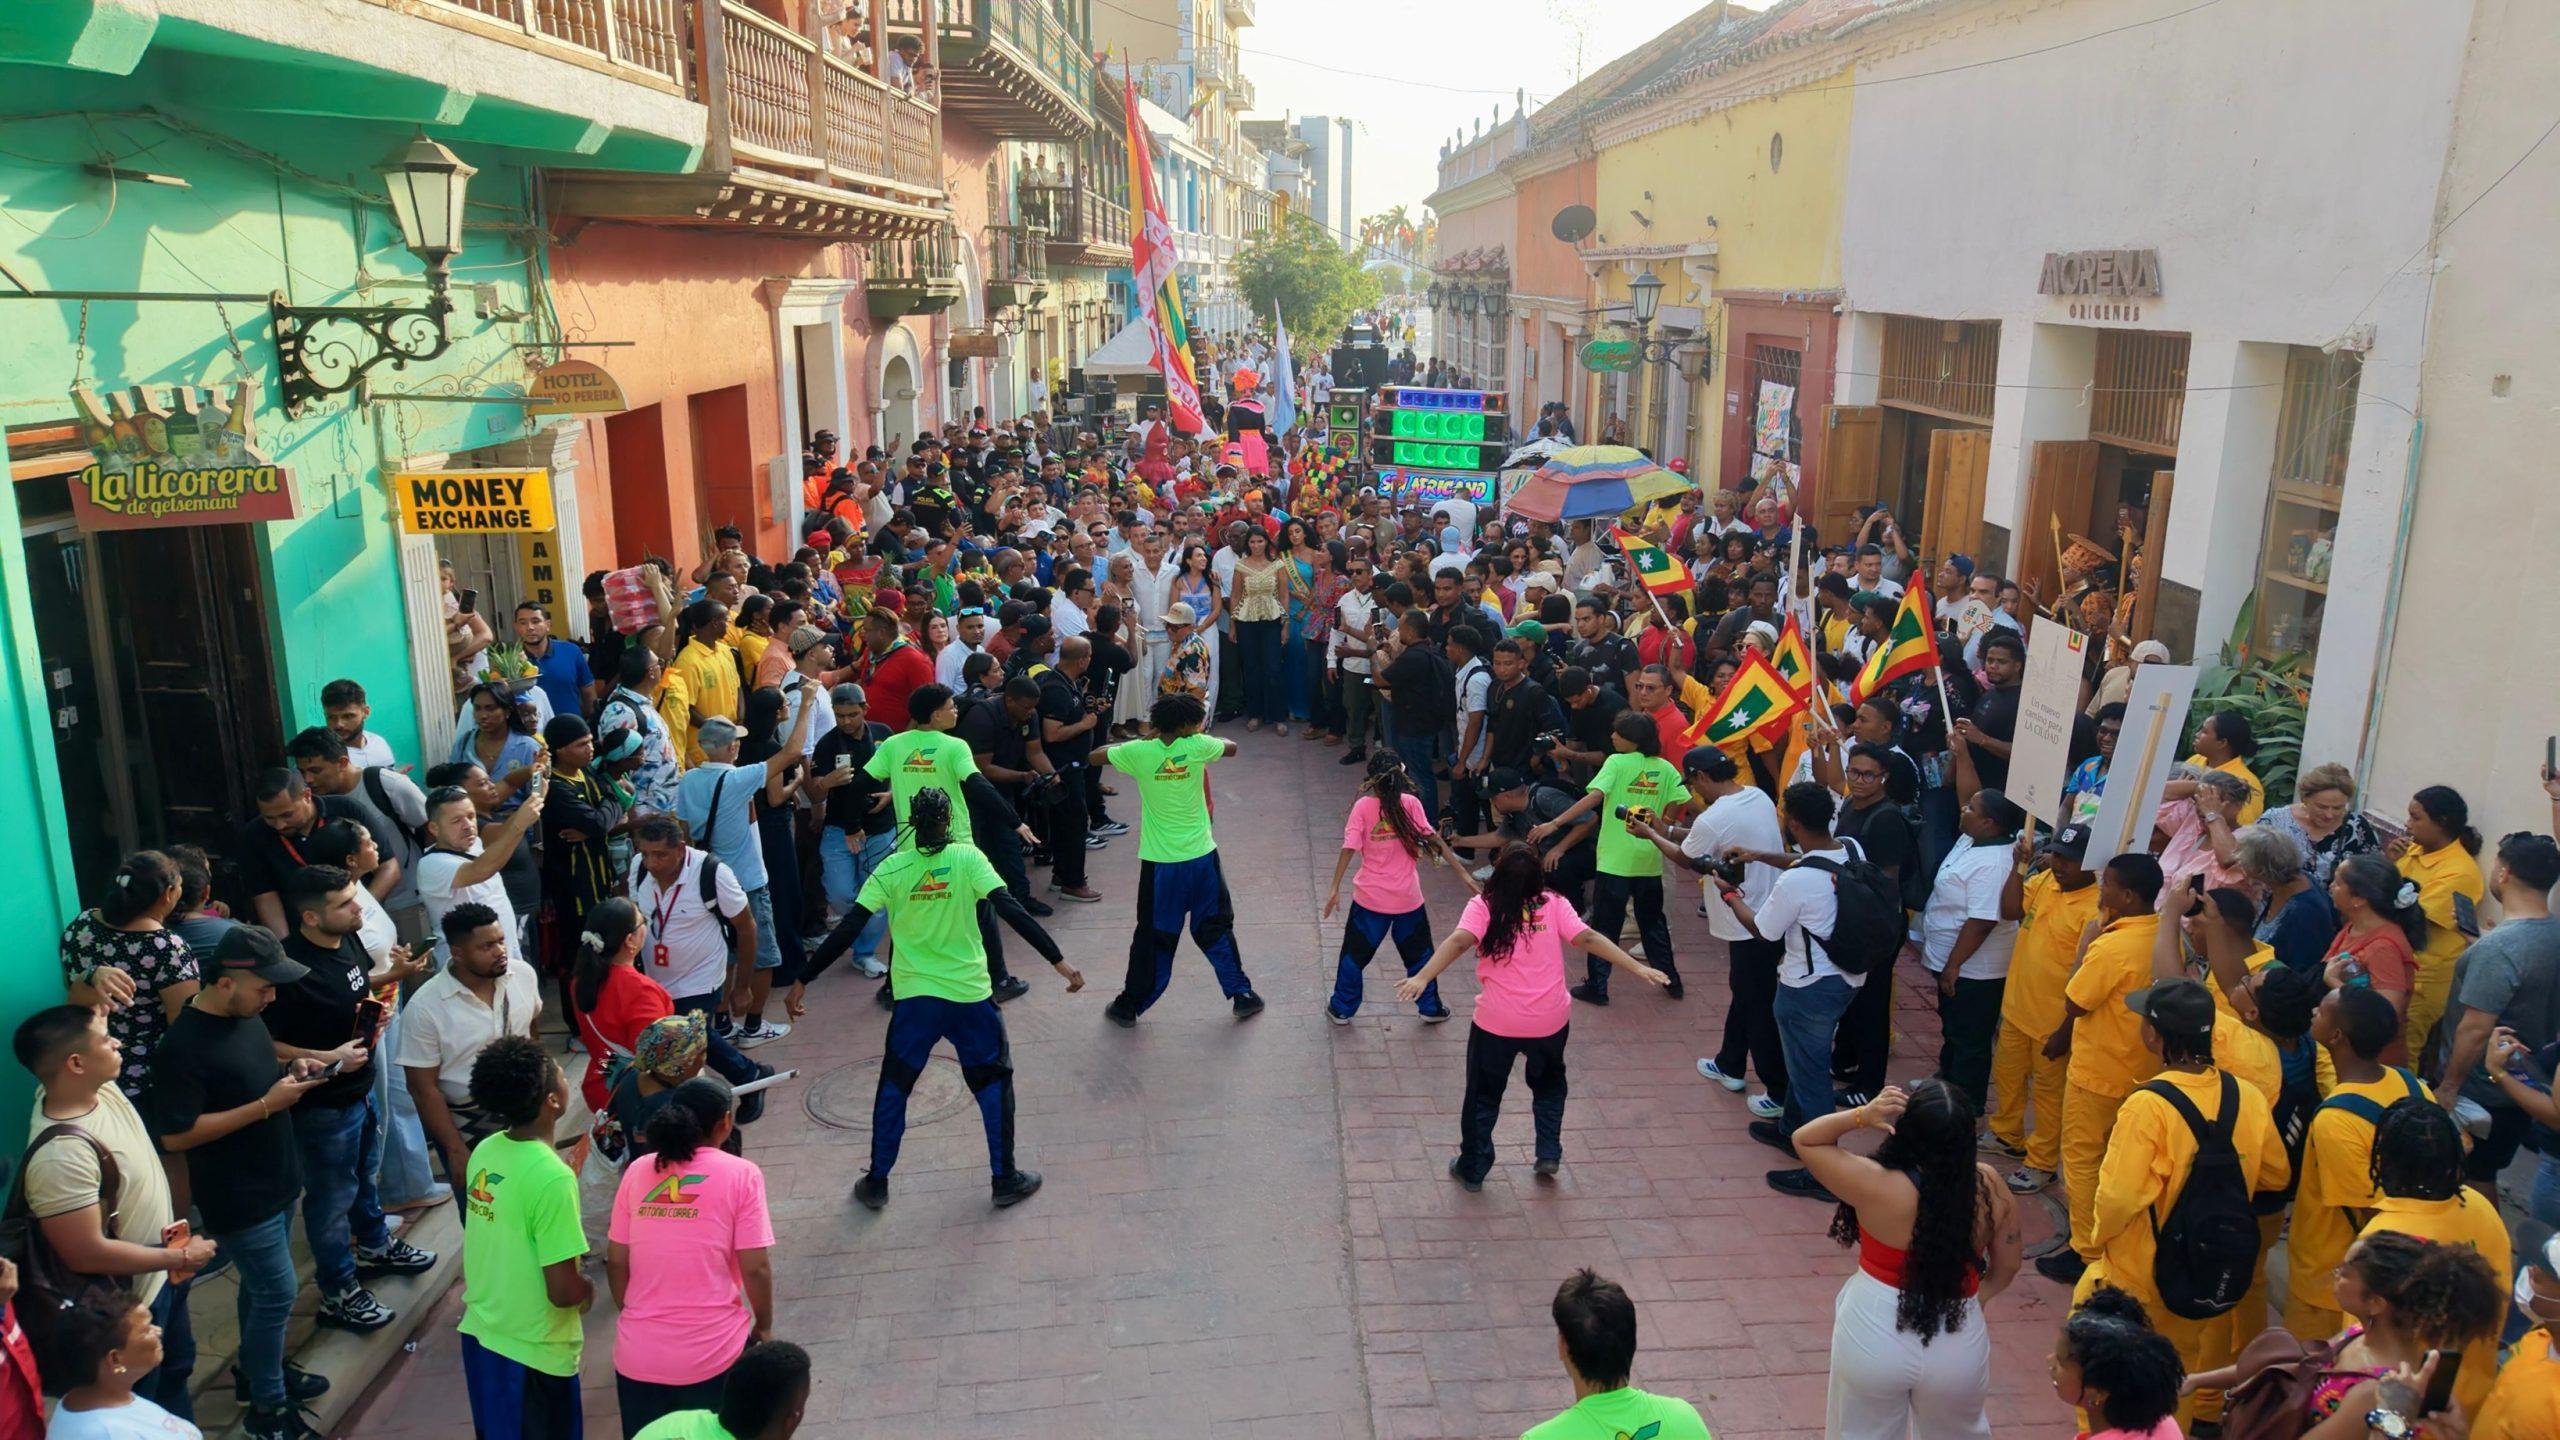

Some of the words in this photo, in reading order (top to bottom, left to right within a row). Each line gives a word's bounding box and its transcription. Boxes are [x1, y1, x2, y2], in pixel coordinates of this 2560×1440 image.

[2069, 303, 2140, 322] ORIGENES
[543, 373, 602, 389] HOTEL
[574, 389, 618, 403] PEREIRA
[80, 462, 128, 513] La
[133, 462, 280, 500] licorera
[410, 478, 525, 508] MONEY
[126, 498, 148, 515] de
[416, 509, 532, 530] EXCHANGE
[2040, 703, 2061, 719] nuevo
[2024, 719, 2033, 733] LA
[2033, 724, 2060, 745] CIUDAD
[638, 1206, 667, 1217] ANTONIO
[668, 1207, 698, 1218] CORREA
